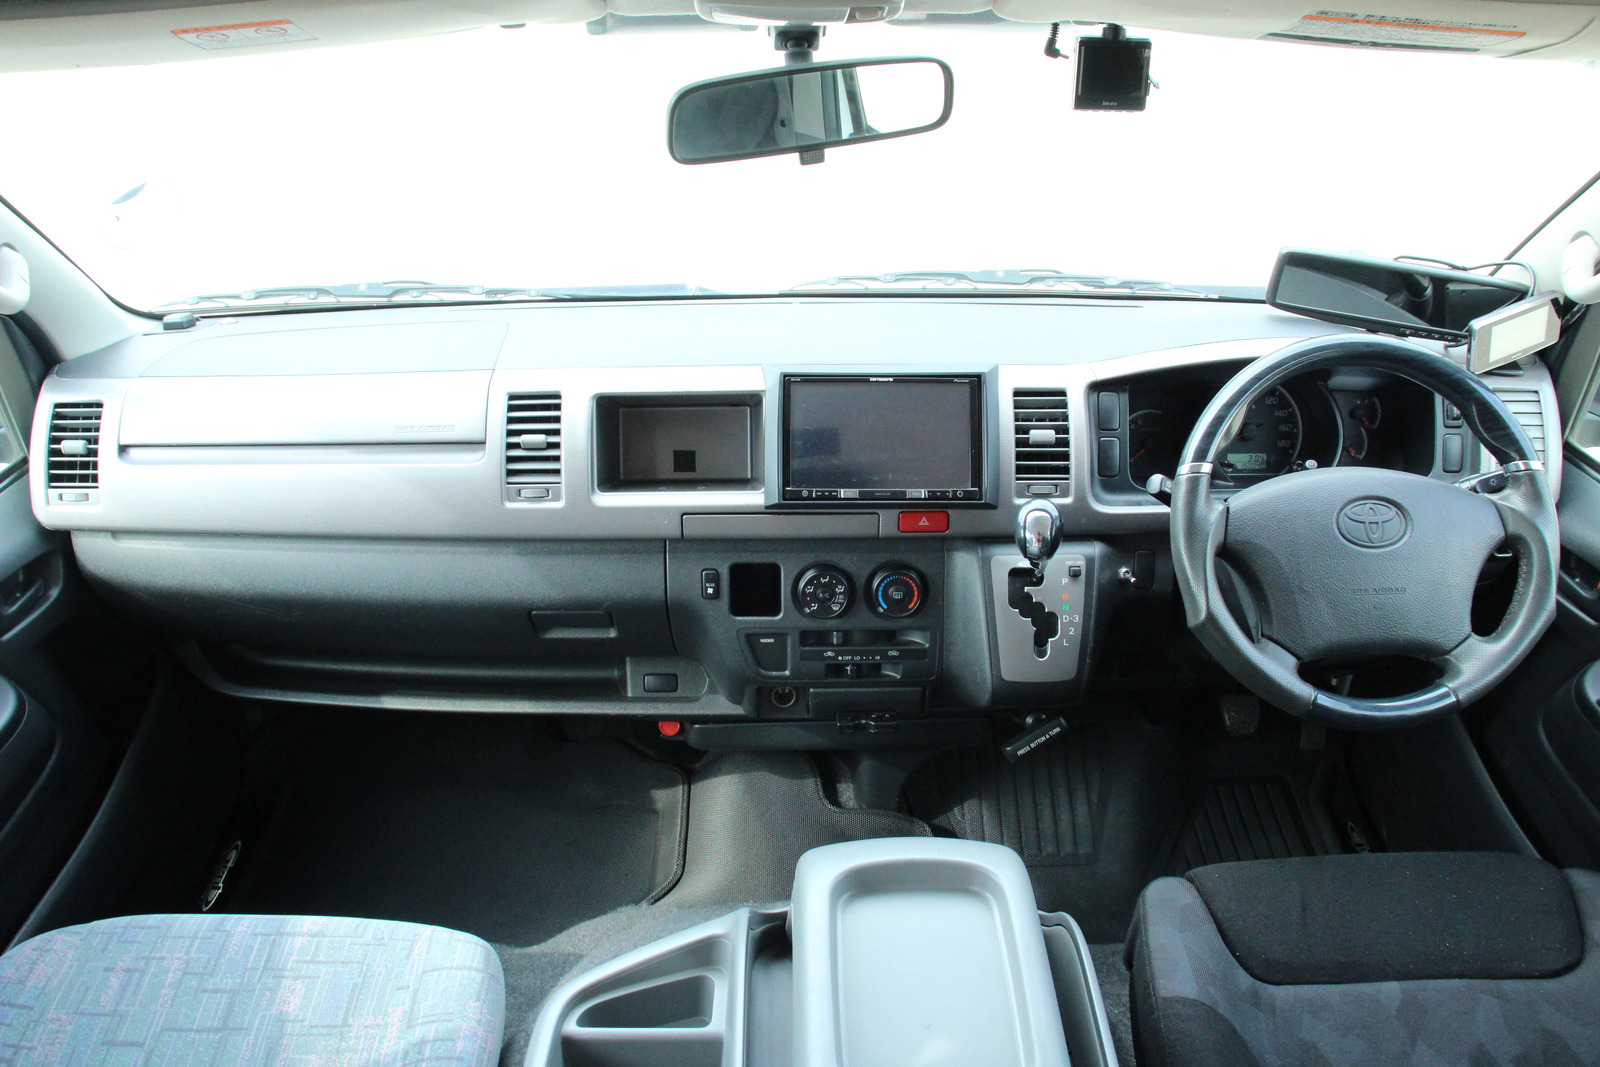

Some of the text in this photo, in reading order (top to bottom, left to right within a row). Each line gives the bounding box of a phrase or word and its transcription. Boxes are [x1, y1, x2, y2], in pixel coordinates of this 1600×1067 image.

[1264, 396, 1279, 405] 120
[1274, 409, 1289, 417] 140
[1062, 578, 1069, 586] P
[1062, 592, 1069, 600] R
[1068, 627, 1075, 635] 2
[1063, 638, 1069, 646] L
[1016, 745, 1031, 757] PRESS
[1030, 735, 1047, 749] BUTTON
[1048, 726, 1061, 737] TURN
